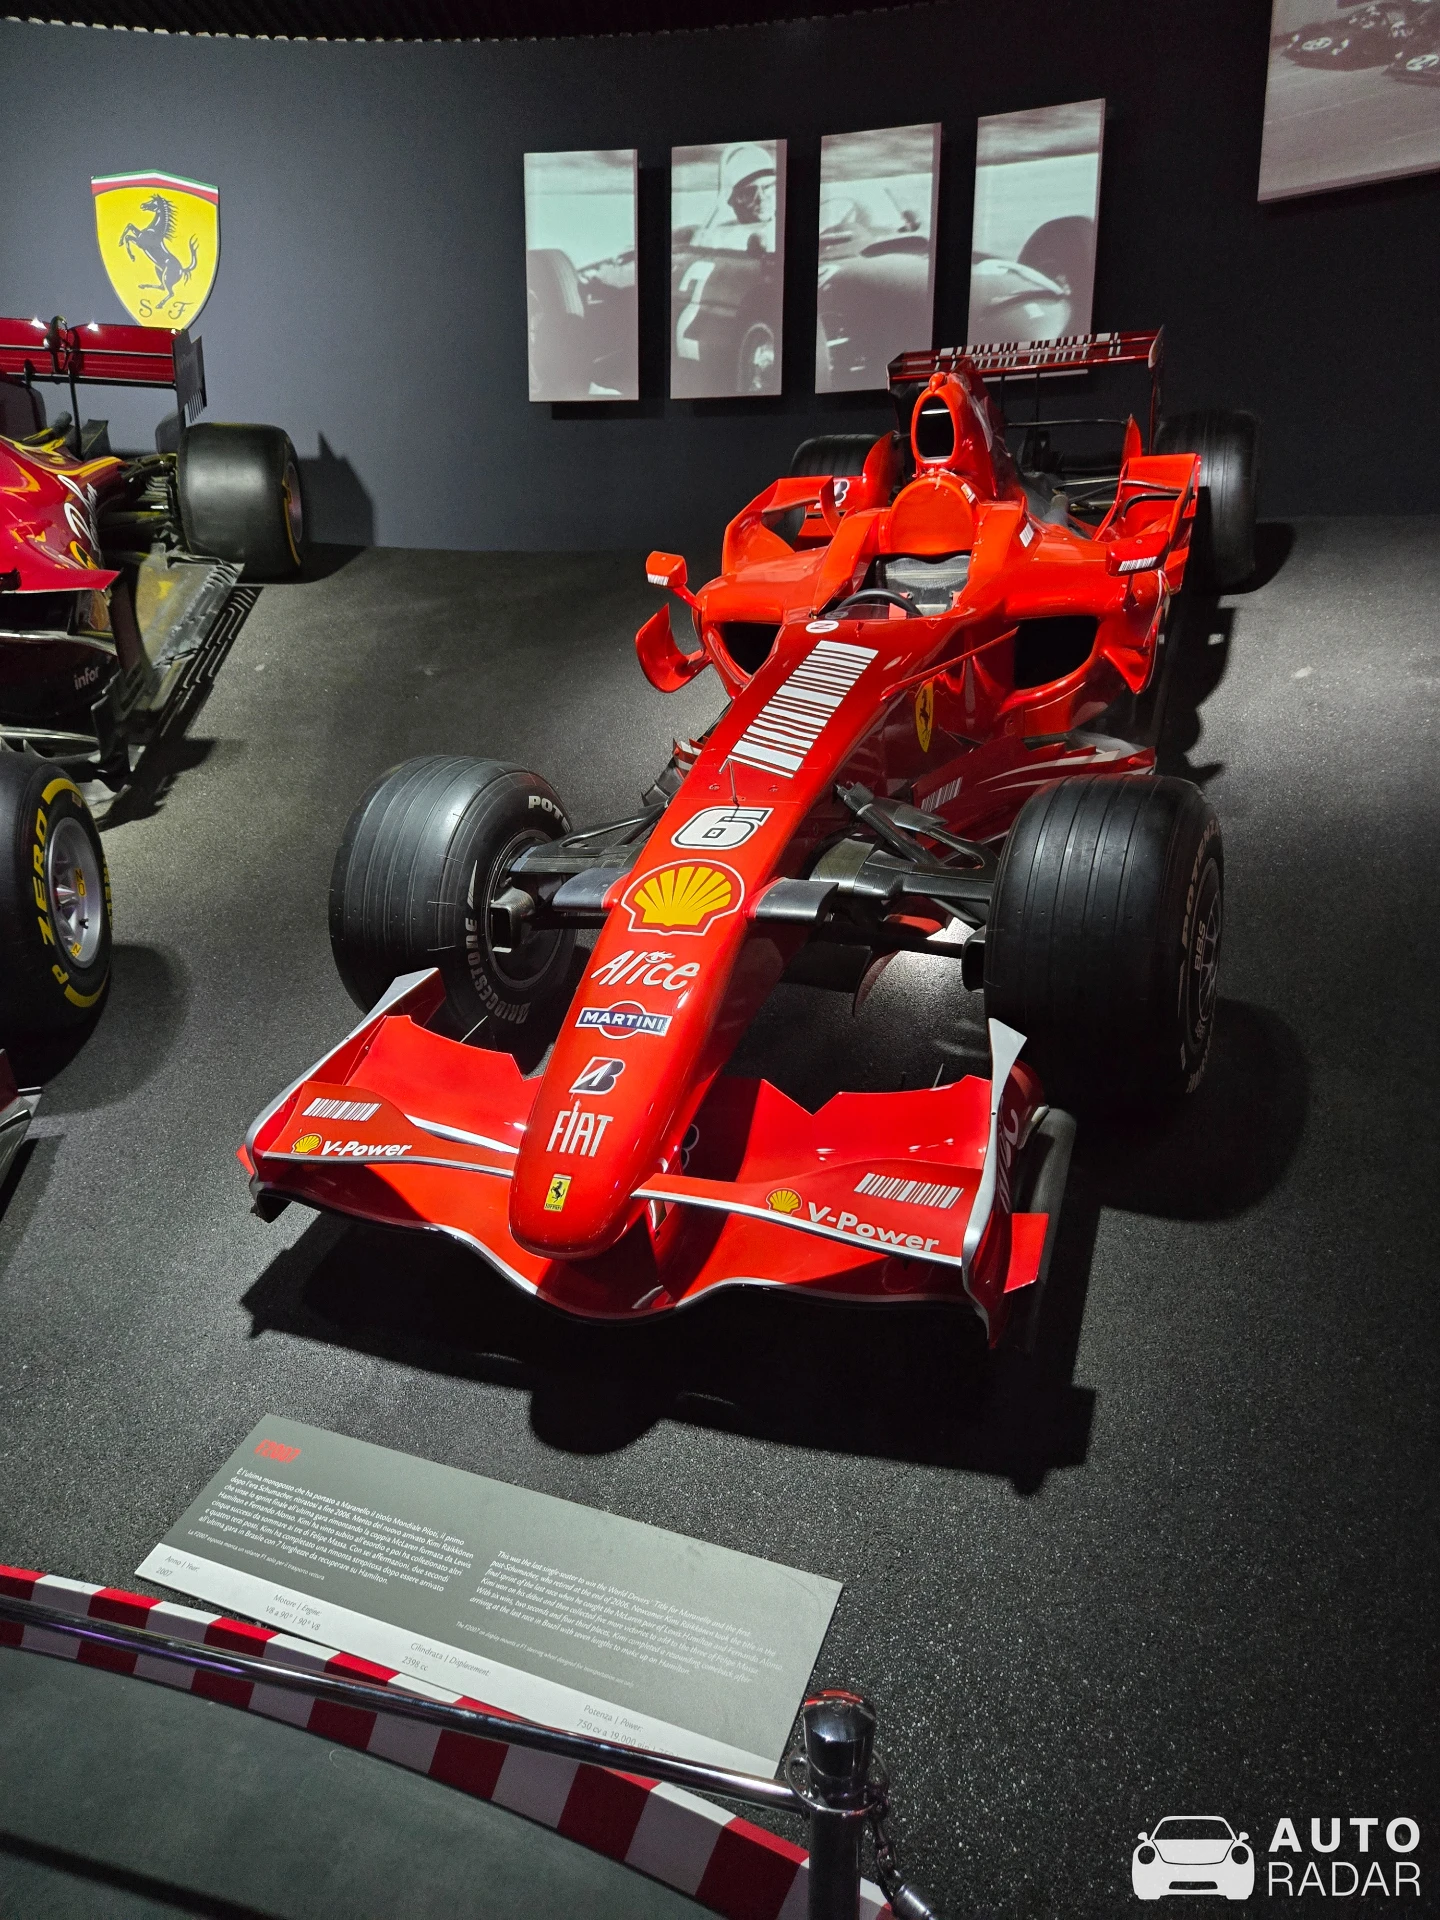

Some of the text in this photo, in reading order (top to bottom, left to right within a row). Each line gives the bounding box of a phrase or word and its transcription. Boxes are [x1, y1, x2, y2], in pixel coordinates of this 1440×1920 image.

[139, 299, 194, 320] S F
[73, 666, 100, 690] infor
[528, 795, 571, 833] POTE
[671, 806, 775, 850] 6
[32, 807, 56, 946] ZERO
[590, 948, 703, 991] Alice
[582, 1010, 668, 1031] MARTINI
[320, 1138, 413, 1157] V-Power
[546, 1107, 614, 1158] FIAT
[807, 1200, 940, 1252] V-Power
[254, 1438, 301, 1463] F2007
[230, 1476, 246, 1486] dopo
[245, 1481, 259, 1489] l'era
[322, 1505, 334, 1514] fine
[334, 1509, 351, 1519] 2006.
[352, 1515, 373, 1526] Merito
[372, 1521, 384, 1529] del
[382, 1526, 402, 1536] nuovo
[402, 1532, 426, 1543] arrivato
[426, 1539, 442, 1548] Kimi
[241, 1470, 263, 1481] l'ultima
[262, 1478, 295, 1491] monoposto
[312, 1494, 336, 1504] portato
[340, 1501, 371, 1516] Maranello
[375, 1513, 392, 1523] titolo
[392, 1518, 421, 1532] Mondiale
[421, 1527, 440, 1539] Piloti,
[444, 1536, 465, 1546] primo
[211, 1500, 231, 1510] cinque
[230, 1507, 254, 1517] successi
[252, 1512, 261, 1520] da
[261, 1517, 288, 1529] sommare
[309, 1531, 328, 1543] Felipe
[327, 1537, 347, 1549] Massa.
[348, 1544, 363, 1554] Con
[411, 1565, 424, 1574] due
[424, 1571, 450, 1583] secondi
[218, 1491, 245, 1504] Hamilton
[248, 1501, 276, 1514] Fernando
[275, 1510, 296, 1522] Alonso.
[297, 1517, 312, 1526] Kimi
[311, 1521, 320, 1529] ha
[319, 1525, 335, 1534] vinto
[335, 1531, 355, 1541] subito
[401, 1551, 411, 1559] ha
[448, 1568, 463, 1576] altri
[234, 1487, 249, 1496] vinse
[255, 1495, 273, 1503] sprint
[272, 1498, 288, 1508] finale
[313, 1514, 329, 1522] gara
[370, 1532, 392, 1542] coppia
[391, 1537, 419, 1551] McLaren
[418, 1546, 444, 1559] formata
[444, 1554, 454, 1563] da
[454, 1557, 472, 1568] Lewis
[165, 1555, 182, 1566] Anno
[208, 1510, 232, 1520] quattro
[231, 1516, 245, 1524] terzi
[242, 1521, 260, 1531] posti,
[260, 1525, 276, 1534] Kimi
[273, 1529, 283, 1537] ha
[328, 1548, 353, 1561] rimonta
[382, 1566, 400, 1577] dopo
[400, 1573, 420, 1583] essere
[419, 1580, 445, 1592] arrivato
[223, 1525, 239, 1533] gara
[244, 1530, 265, 1542] Brasile
[264, 1538, 276, 1546] con
[280, 1542, 310, 1557] lunghezze
[309, 1552, 318, 1560] da
[358, 1568, 388, 1584] Hamilton.
[156, 1567, 173, 1577] 2007
[265, 1606, 276, 1614] V8
[310, 1622, 321, 1631] V8
[274, 1594, 322, 1616] Motore Engine:
[402, 1656, 421, 1668] 2398
[410, 1643, 491, 1677] Cilindrata Displacement:
[577, 1719, 593, 1731] 750
[584, 1705, 644, 1732] Potenza Power:
